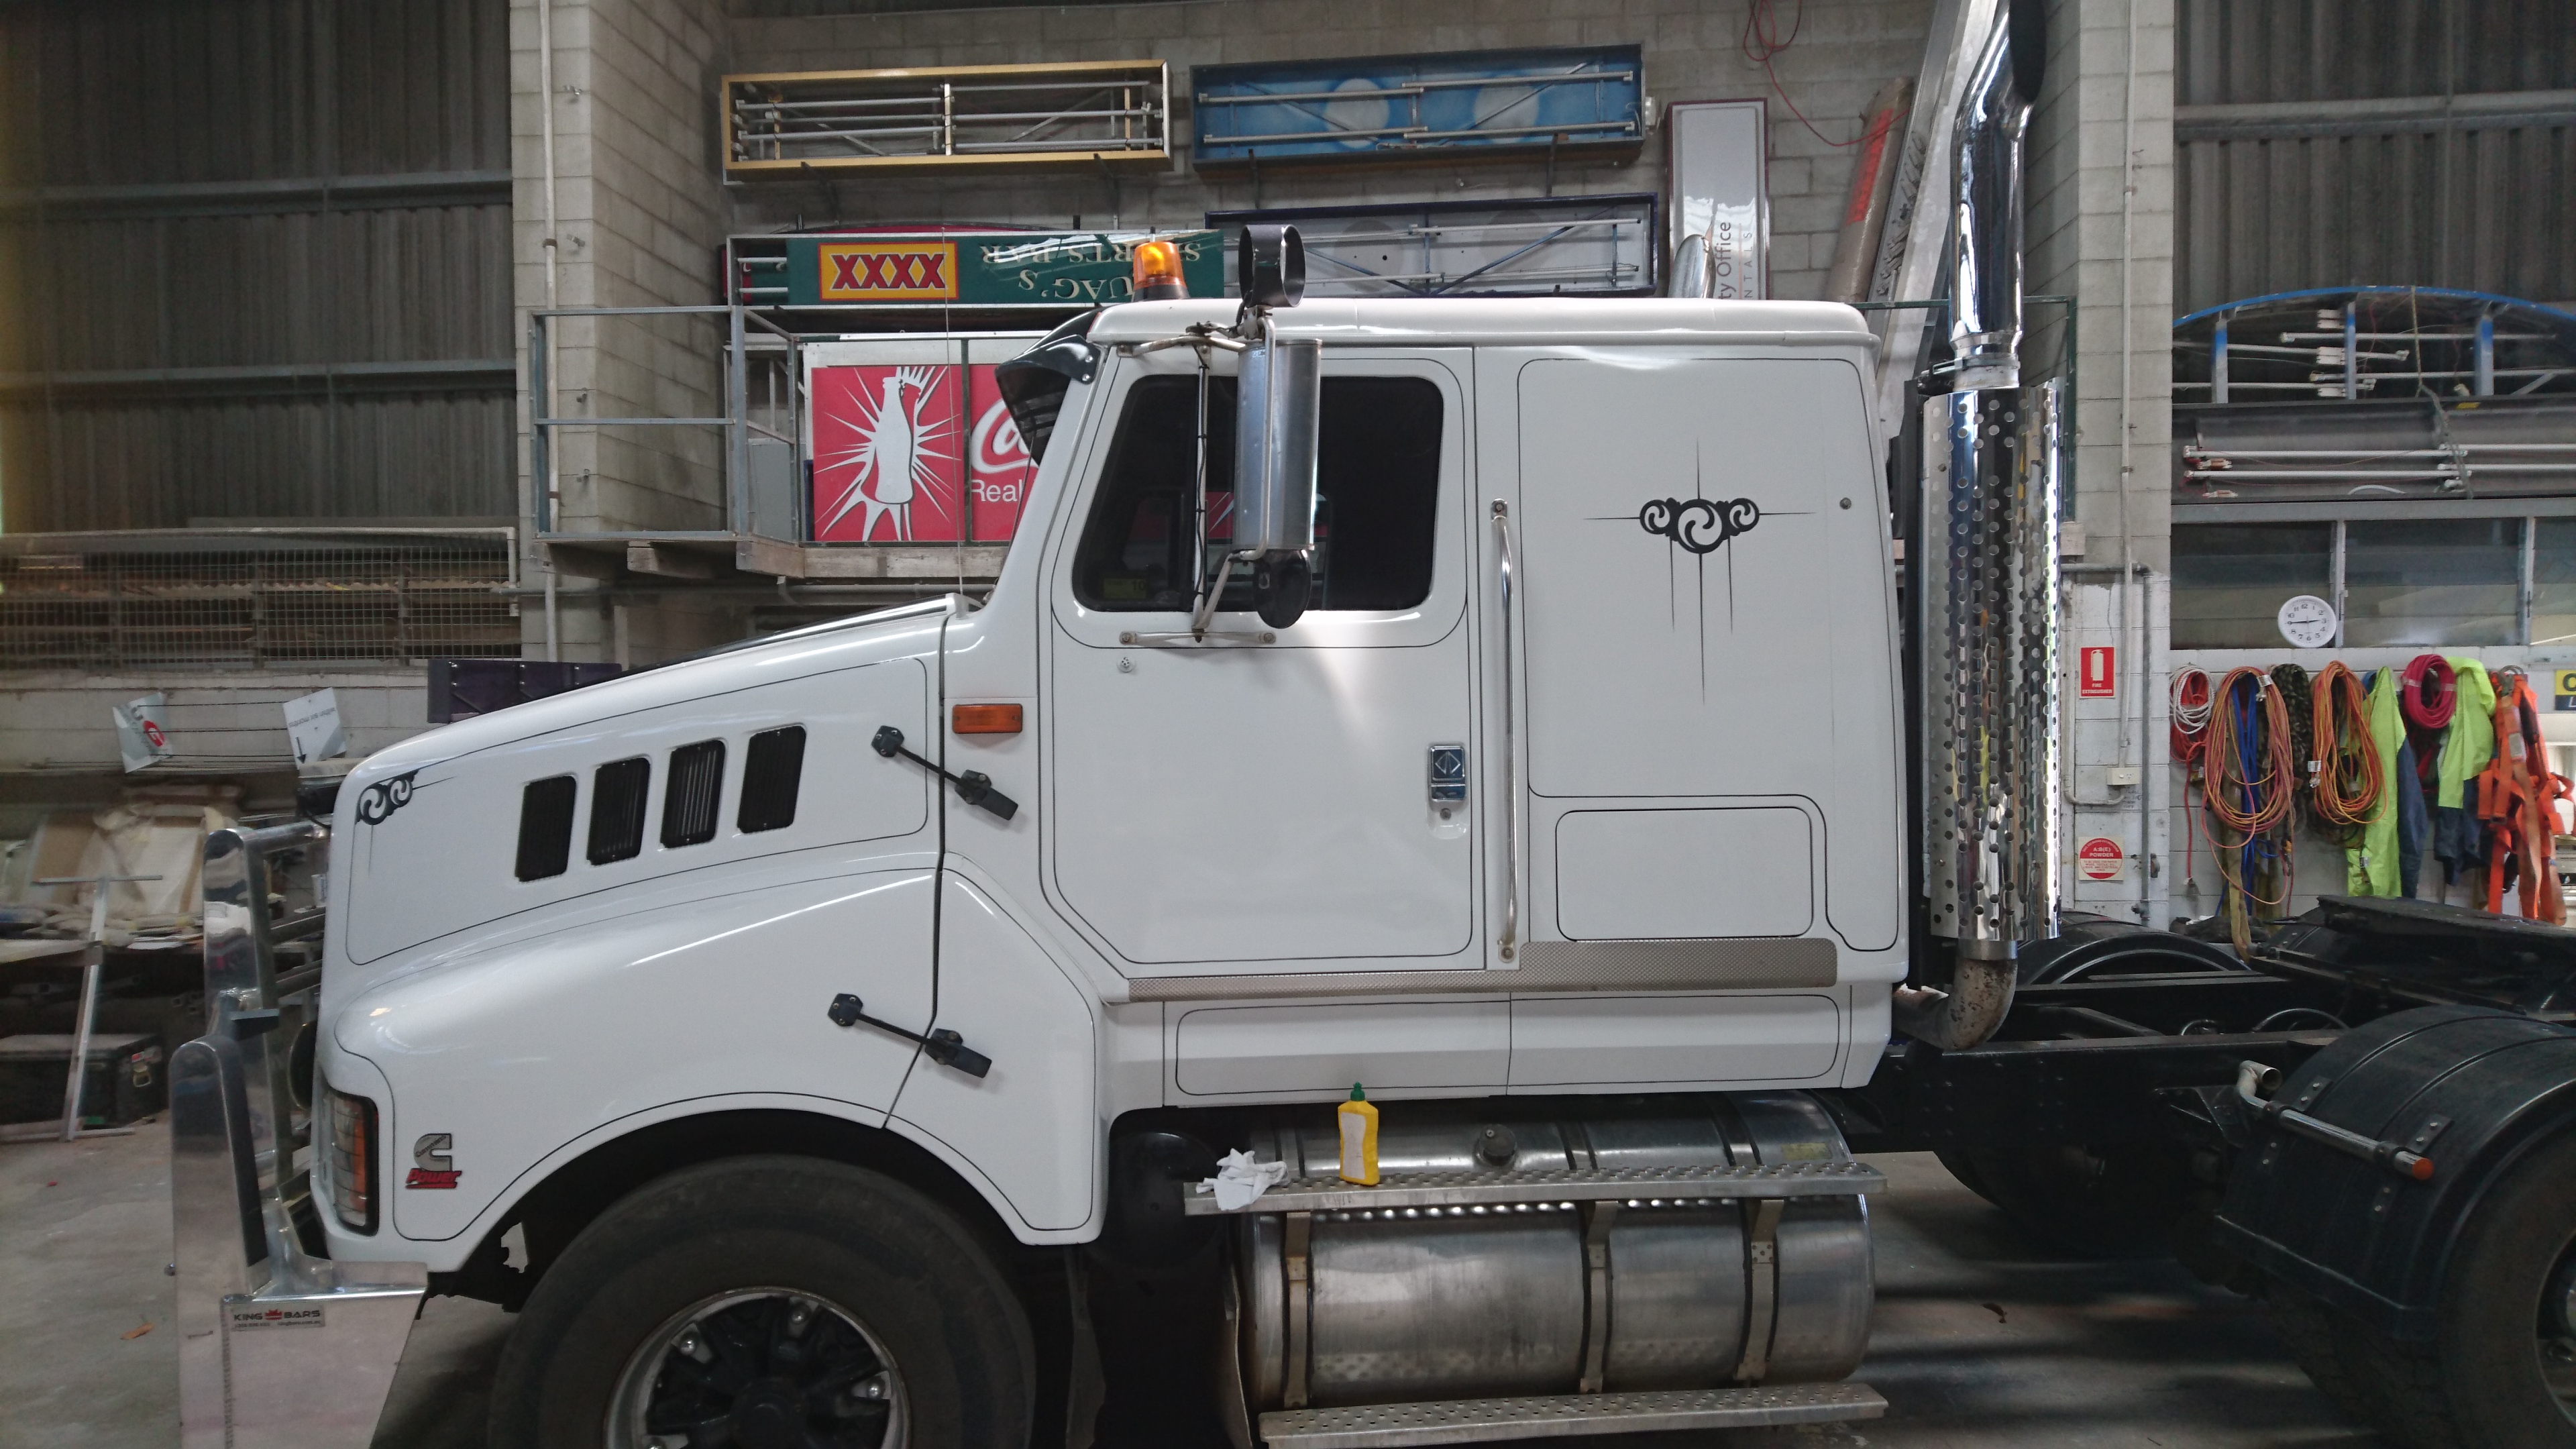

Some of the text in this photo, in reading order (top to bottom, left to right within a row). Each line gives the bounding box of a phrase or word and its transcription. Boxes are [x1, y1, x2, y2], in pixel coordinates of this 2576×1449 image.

[980, 243, 1201, 264] SRTS BAR
[1715, 222, 1731, 277] Office
[829, 252, 948, 290] XXXX
[1018, 269, 1135, 300] UAG'S
[971, 479, 1024, 502] Real
[406, 1168, 462, 1184] Power
[284, 1310, 321, 1318] BARS
